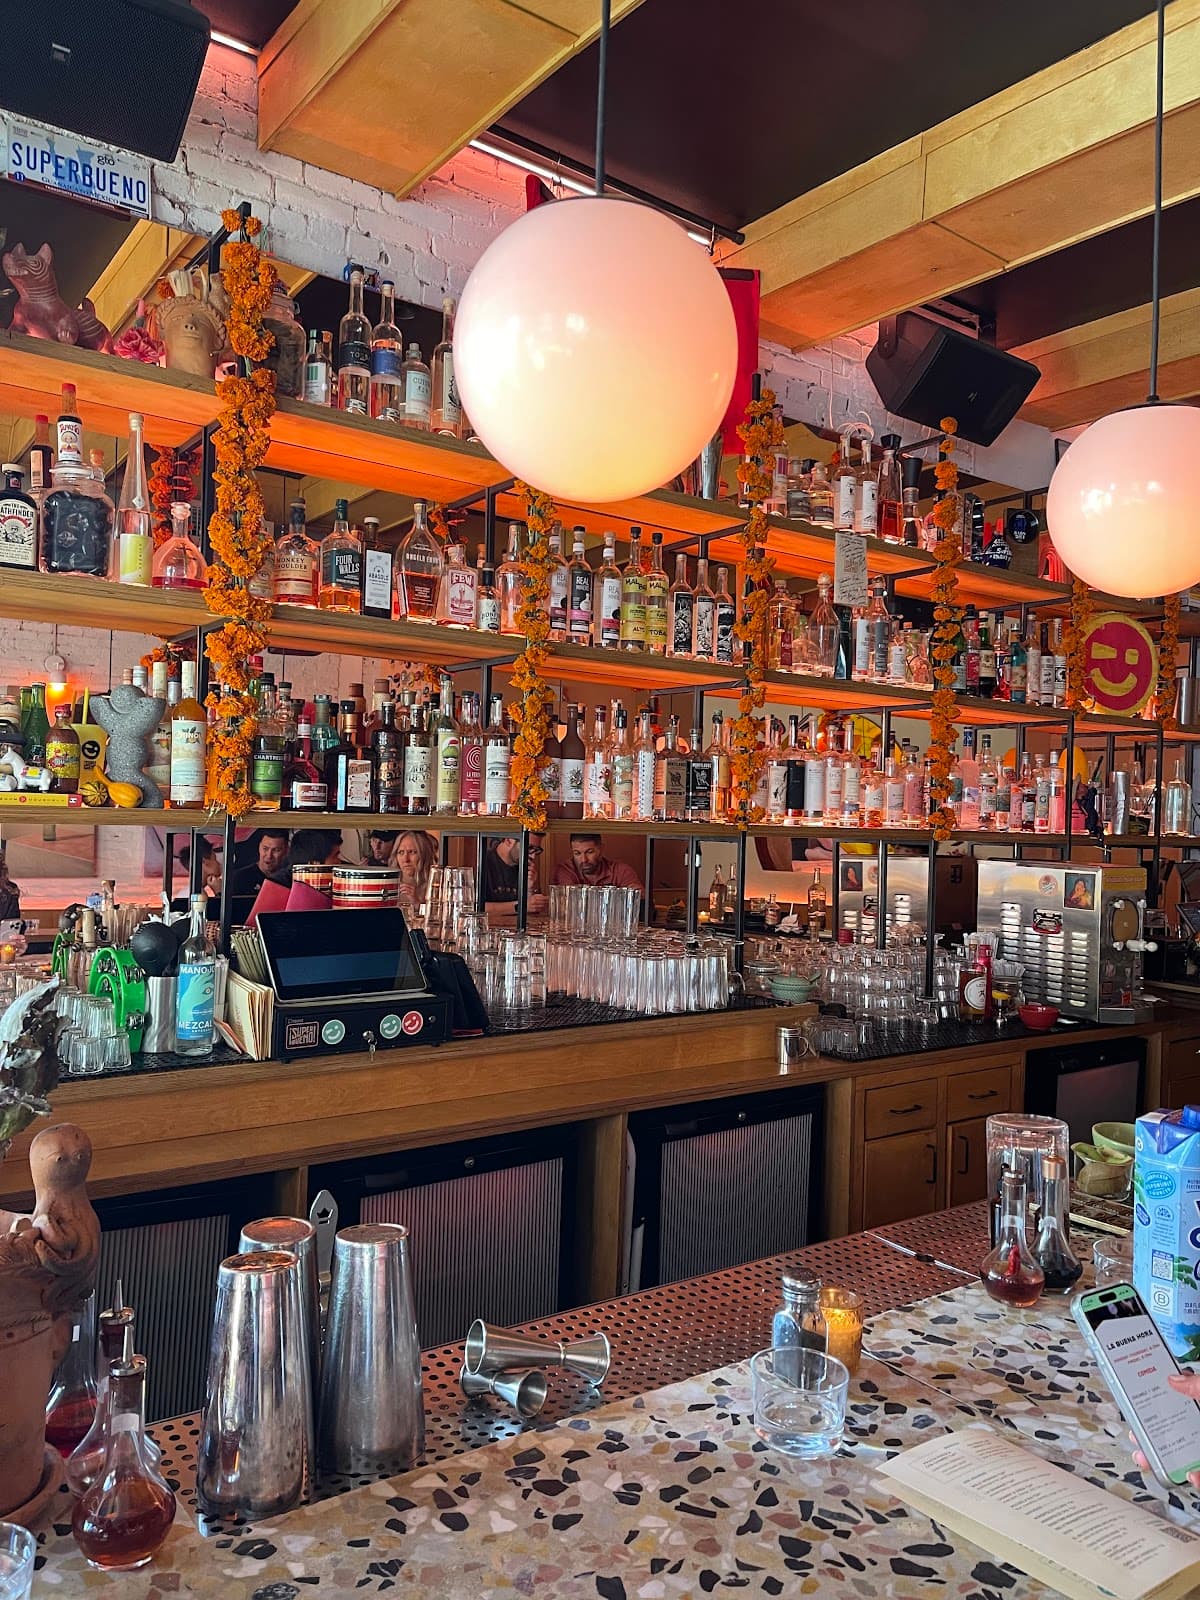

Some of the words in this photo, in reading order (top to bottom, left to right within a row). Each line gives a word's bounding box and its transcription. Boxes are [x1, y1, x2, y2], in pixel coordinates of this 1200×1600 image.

[12, 142, 146, 204] SUPERBUENO
[0, 507, 34, 518] ATHFINDER
[335, 555, 353, 566] FOUR
[339, 564, 360, 575] WALLS
[452, 573, 473, 586] FEW
[576, 576, 590, 585] REAL
[1106, 1343, 1116, 1351] LA
[1115, 1335, 1137, 1347] BUENA
[1136, 1329, 1153, 1340] HORA
